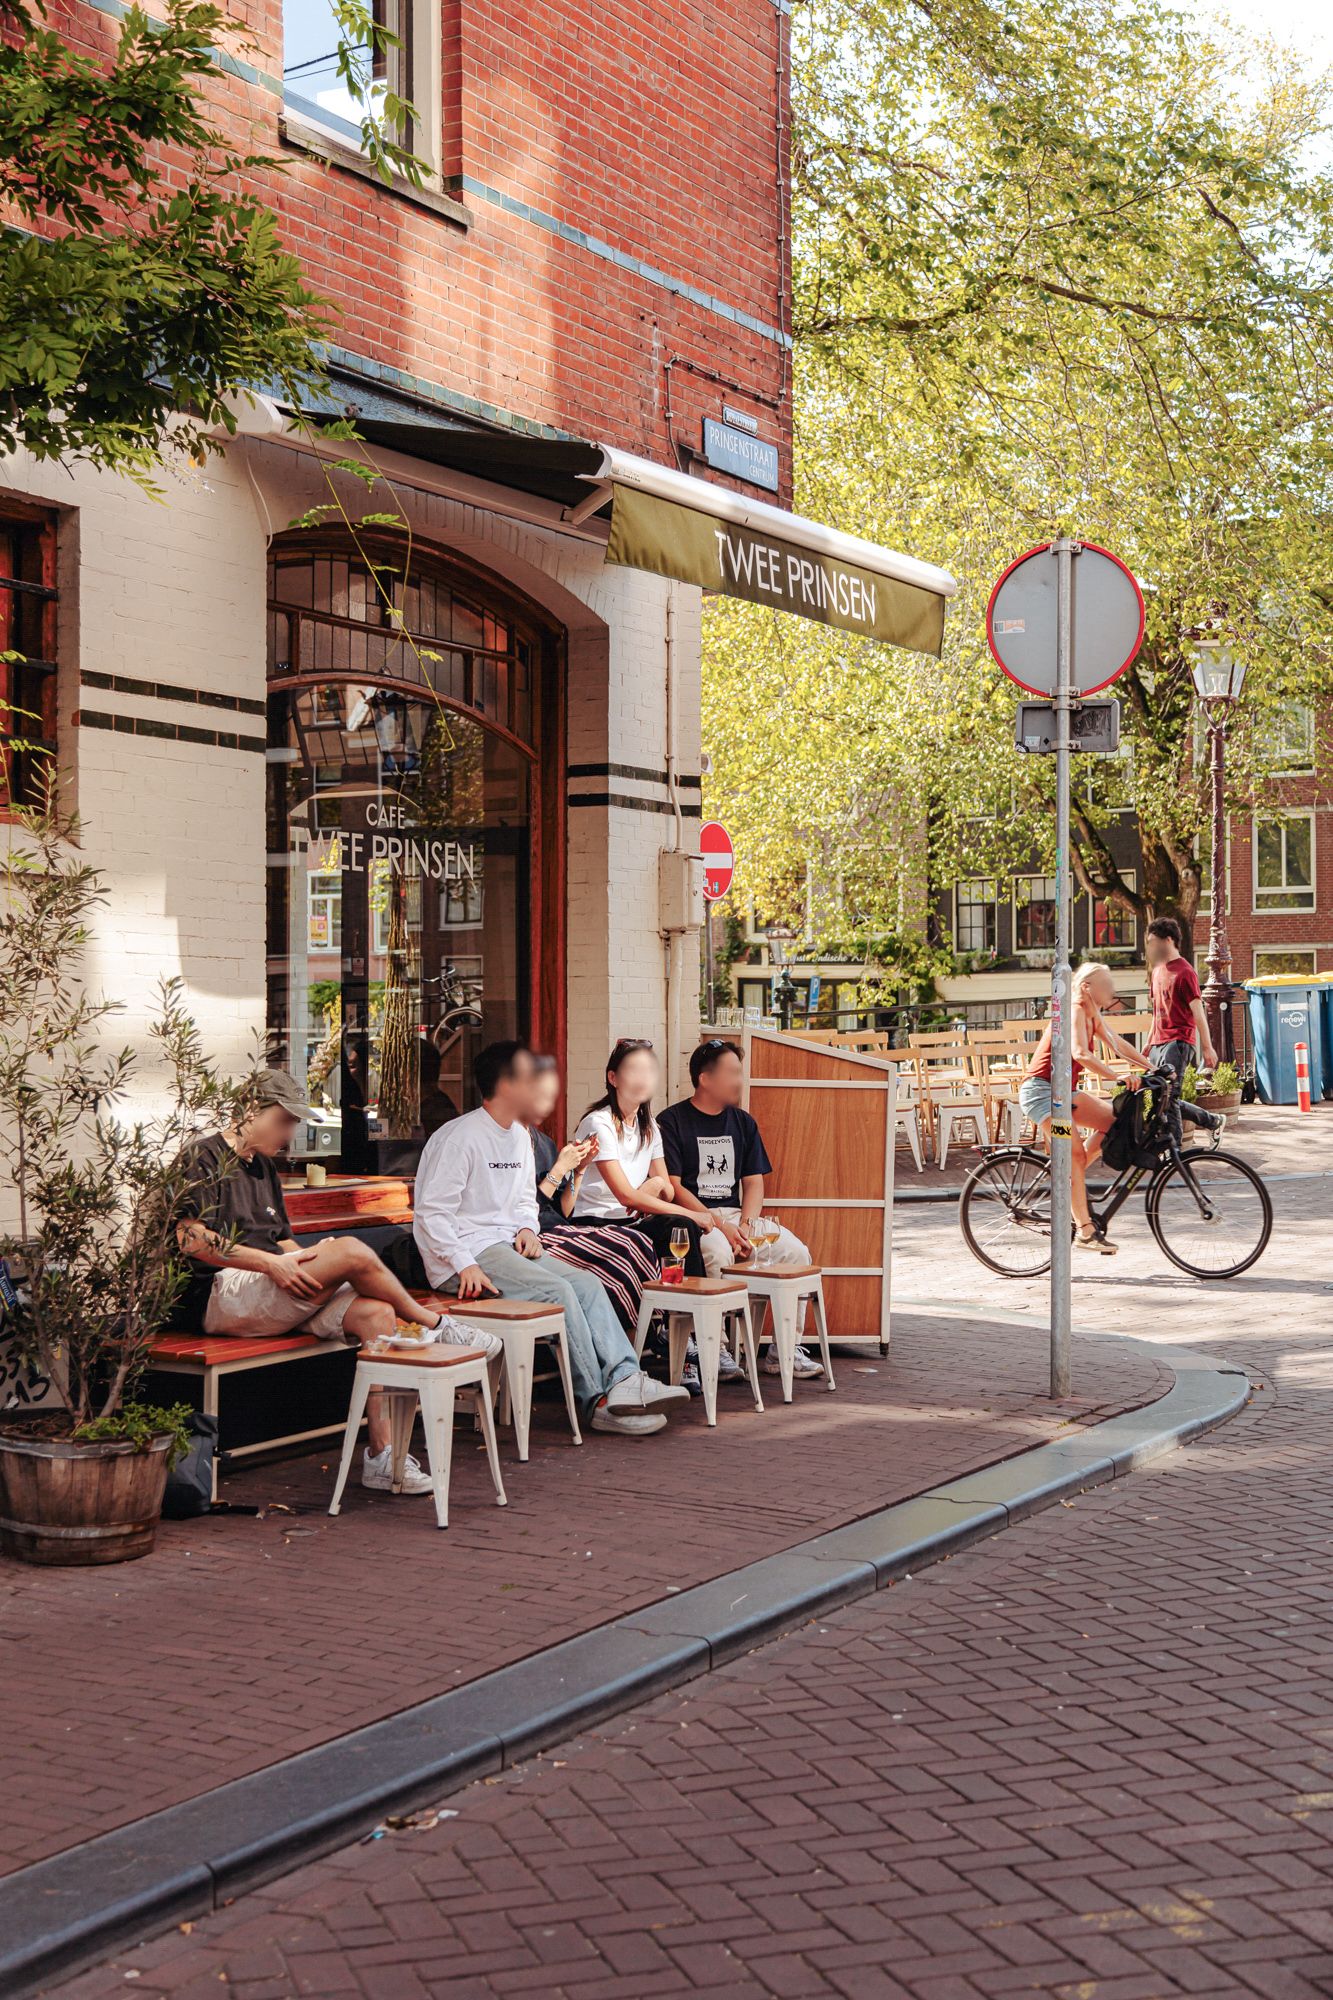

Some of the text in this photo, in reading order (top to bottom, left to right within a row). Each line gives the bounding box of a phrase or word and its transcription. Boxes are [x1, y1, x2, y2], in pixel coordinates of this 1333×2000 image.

[709, 426, 774, 469] PRINSENSTRAAT
[749, 464, 775, 483] CENTRUM
[714, 530, 876, 626] TWEE PRINSEN
[366, 803, 406, 830] CAFE
[290, 826, 474, 880] TWEE PRINSEN
